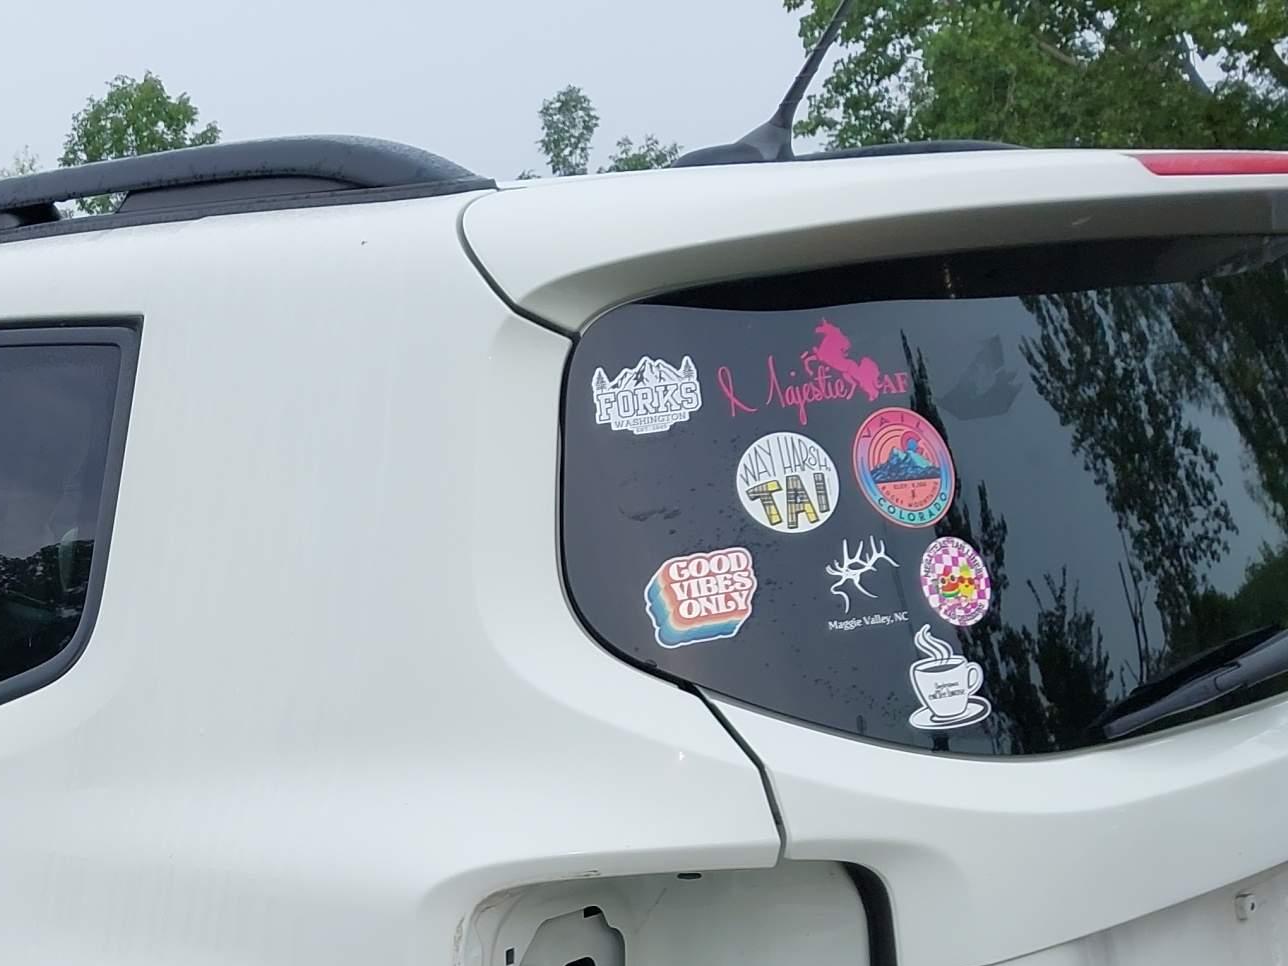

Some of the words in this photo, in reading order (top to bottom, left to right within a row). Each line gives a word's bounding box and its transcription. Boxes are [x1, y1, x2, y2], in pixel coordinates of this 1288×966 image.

[882, 372, 909, 394] AF
[597, 381, 699, 421] FORKS
[614, 412, 686, 428] WASHINGTON
[740, 440, 778, 486] WAY
[746, 472, 830, 529] TAI
[877, 491, 947, 521] COLORADO
[669, 552, 748, 581] GOOD
[670, 571, 753, 601] VIBES
[679, 590, 750, 619] ONLY
[828, 617, 862, 630] Maggie
[862, 614, 894, 626] Valley,
[894, 611, 909, 622] NC
